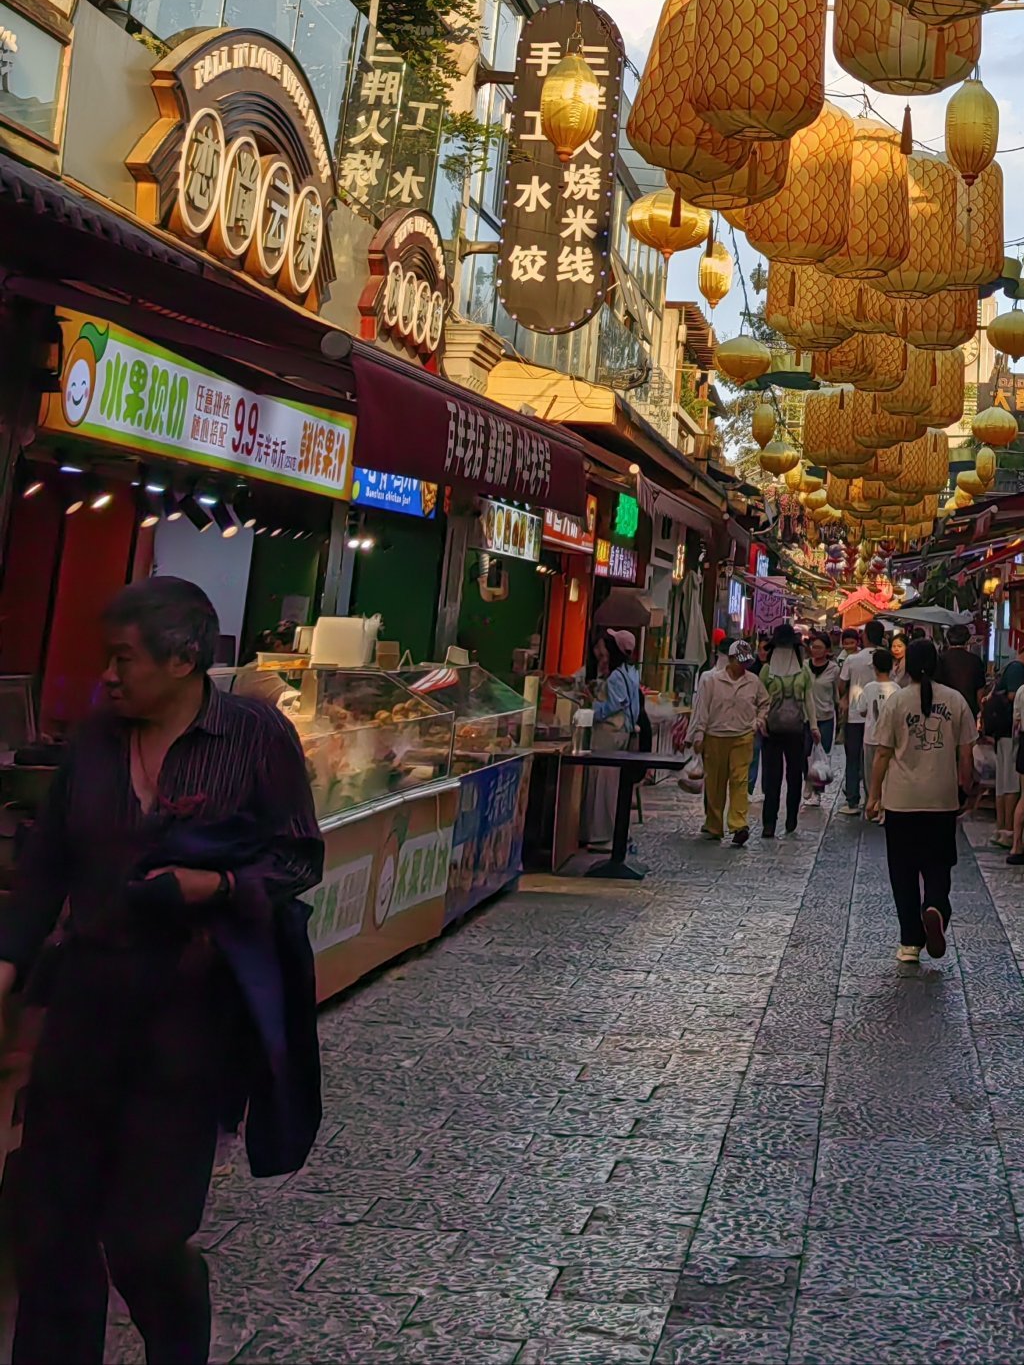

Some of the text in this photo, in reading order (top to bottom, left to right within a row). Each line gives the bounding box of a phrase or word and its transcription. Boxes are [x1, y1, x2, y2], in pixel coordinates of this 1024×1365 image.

[193, 46, 232, 90] FALL
[249, 44, 283, 81] LOVE
[100, 351, 189, 441] 水果现切
[195, 384, 231, 421] 任意挑选
[191, 413, 229, 449] 随心搭配
[297, 420, 346, 483] 鲜榨果汁
[444, 400, 485, 481] 百年老店
[515, 427, 551, 499] 中华老字号
